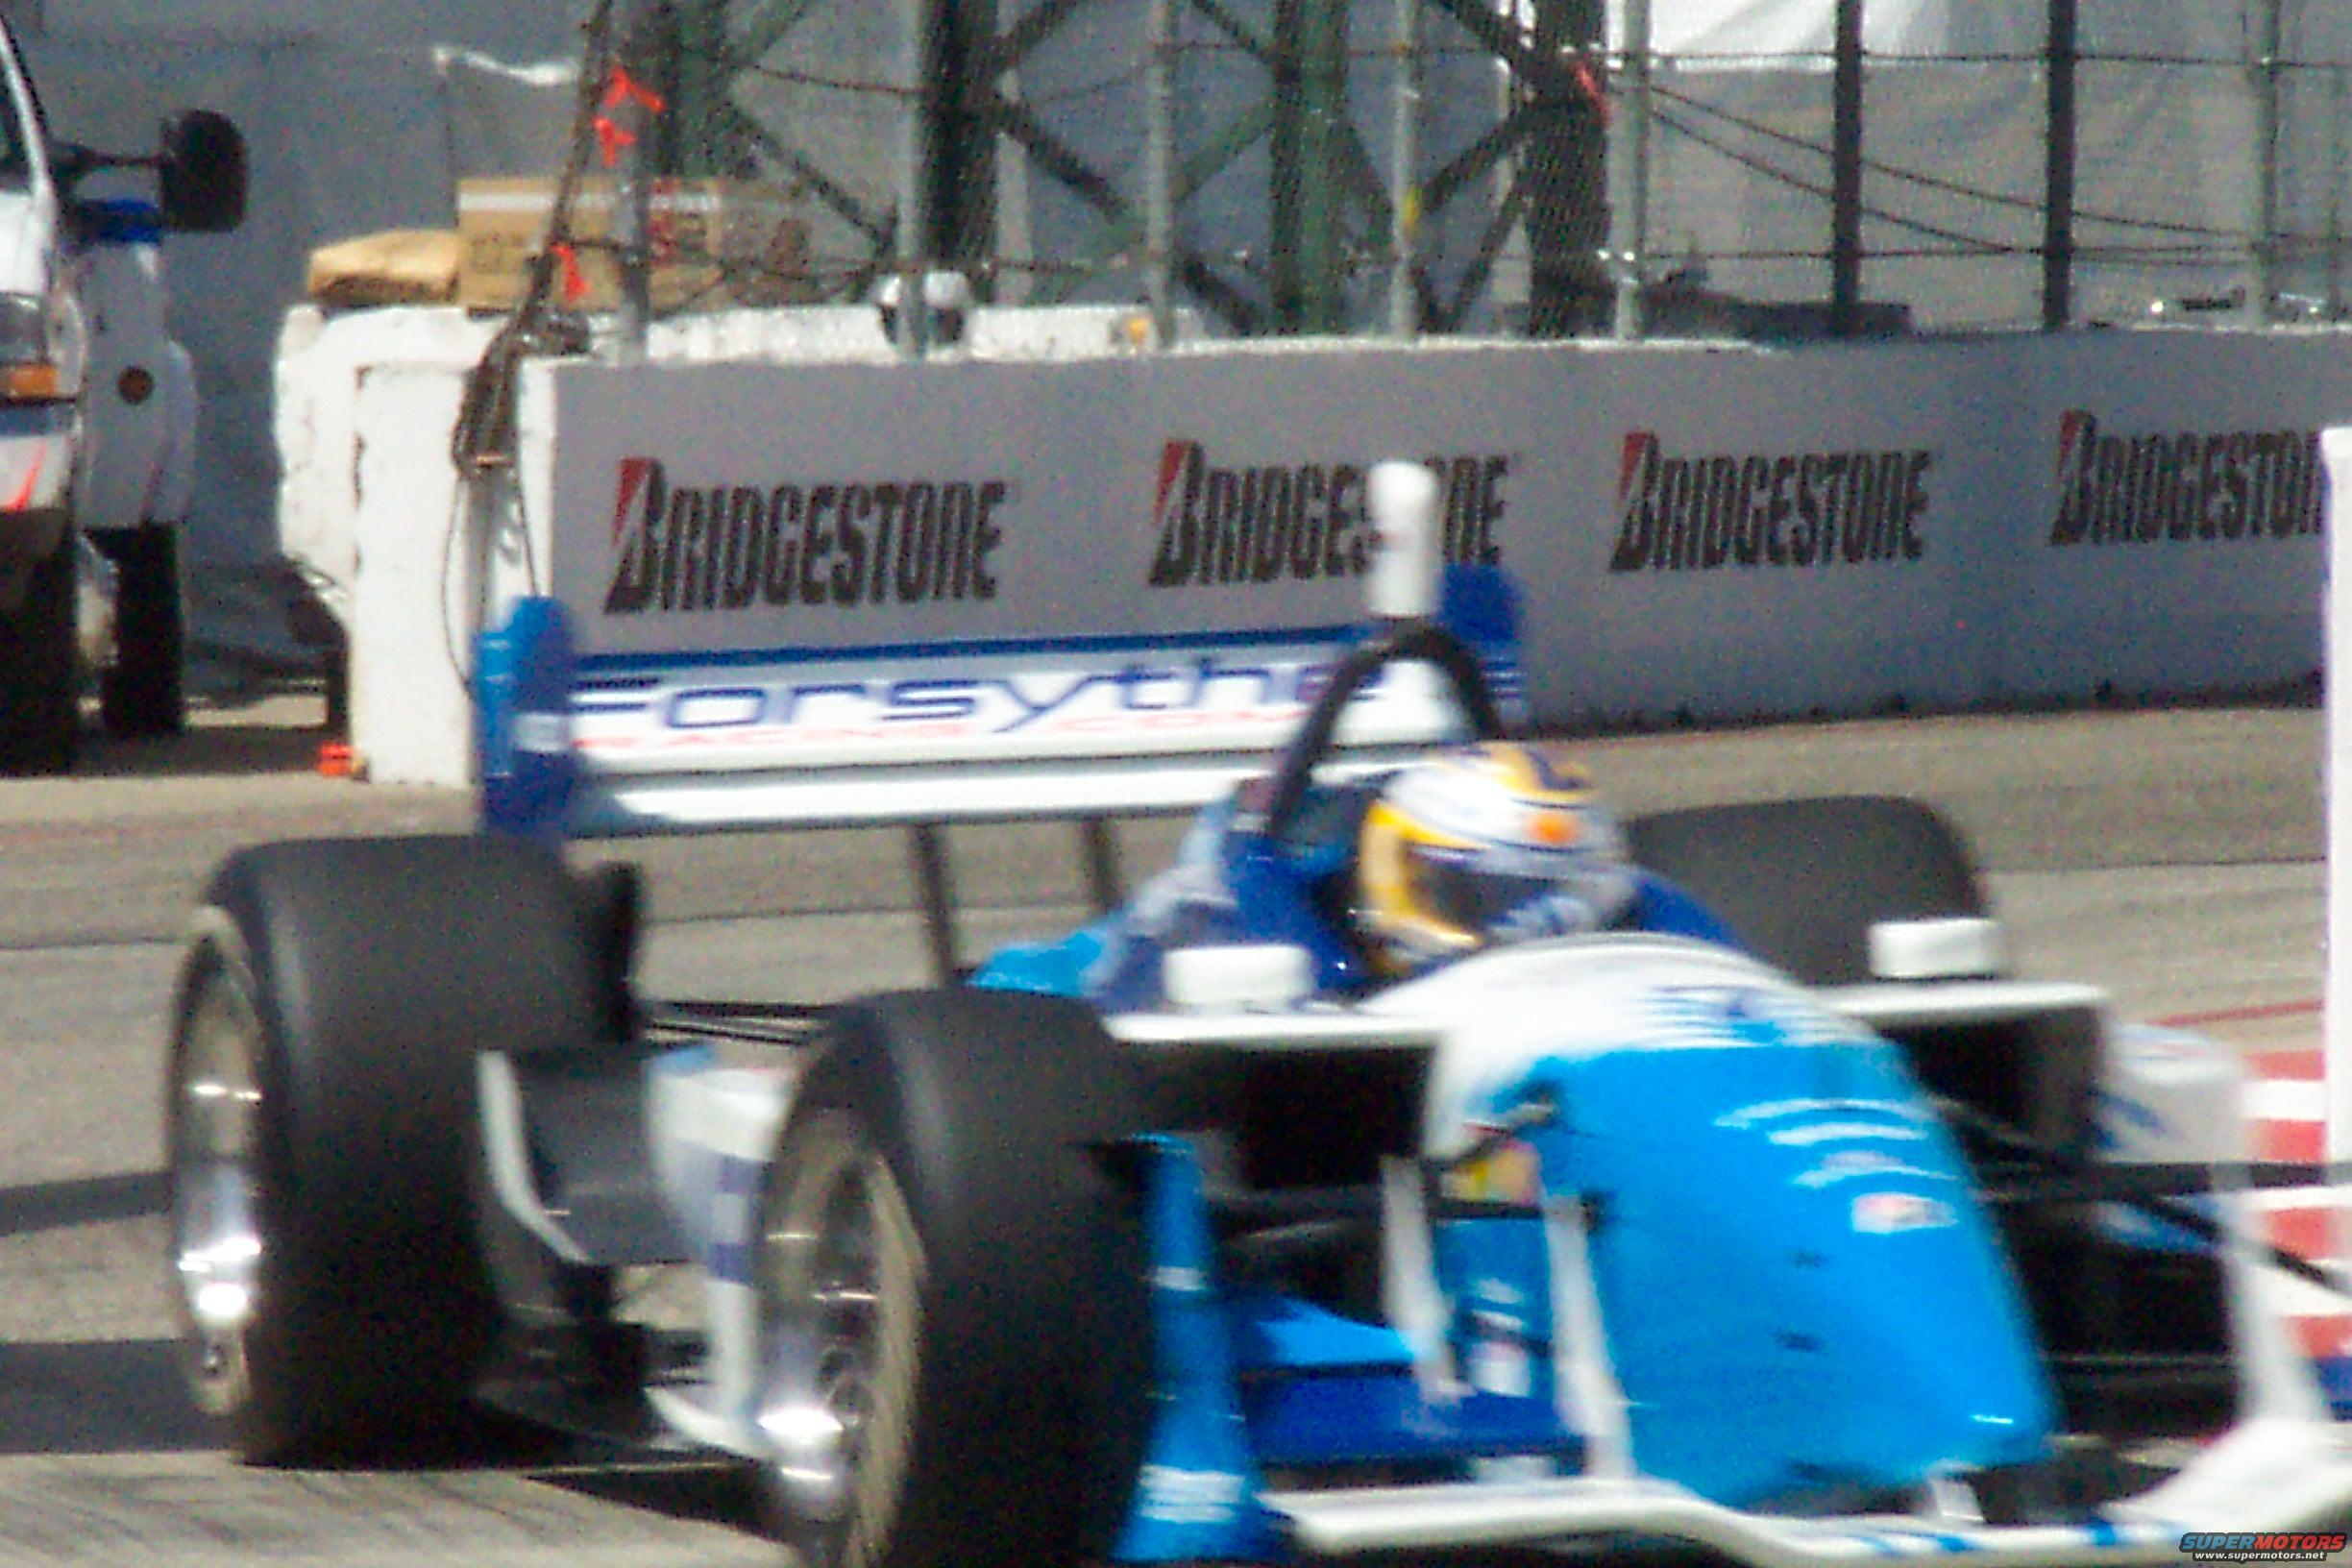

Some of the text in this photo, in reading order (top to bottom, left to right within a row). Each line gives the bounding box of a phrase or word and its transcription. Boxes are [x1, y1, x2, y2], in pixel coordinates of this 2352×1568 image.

[603, 456, 1006, 614] BRIDGESTONE
[1150, 439, 1509, 587] BRIDGENE
[1609, 429, 1931, 573] BRIDGESTONE
[2049, 409, 2323, 545] BRIDGESTON
